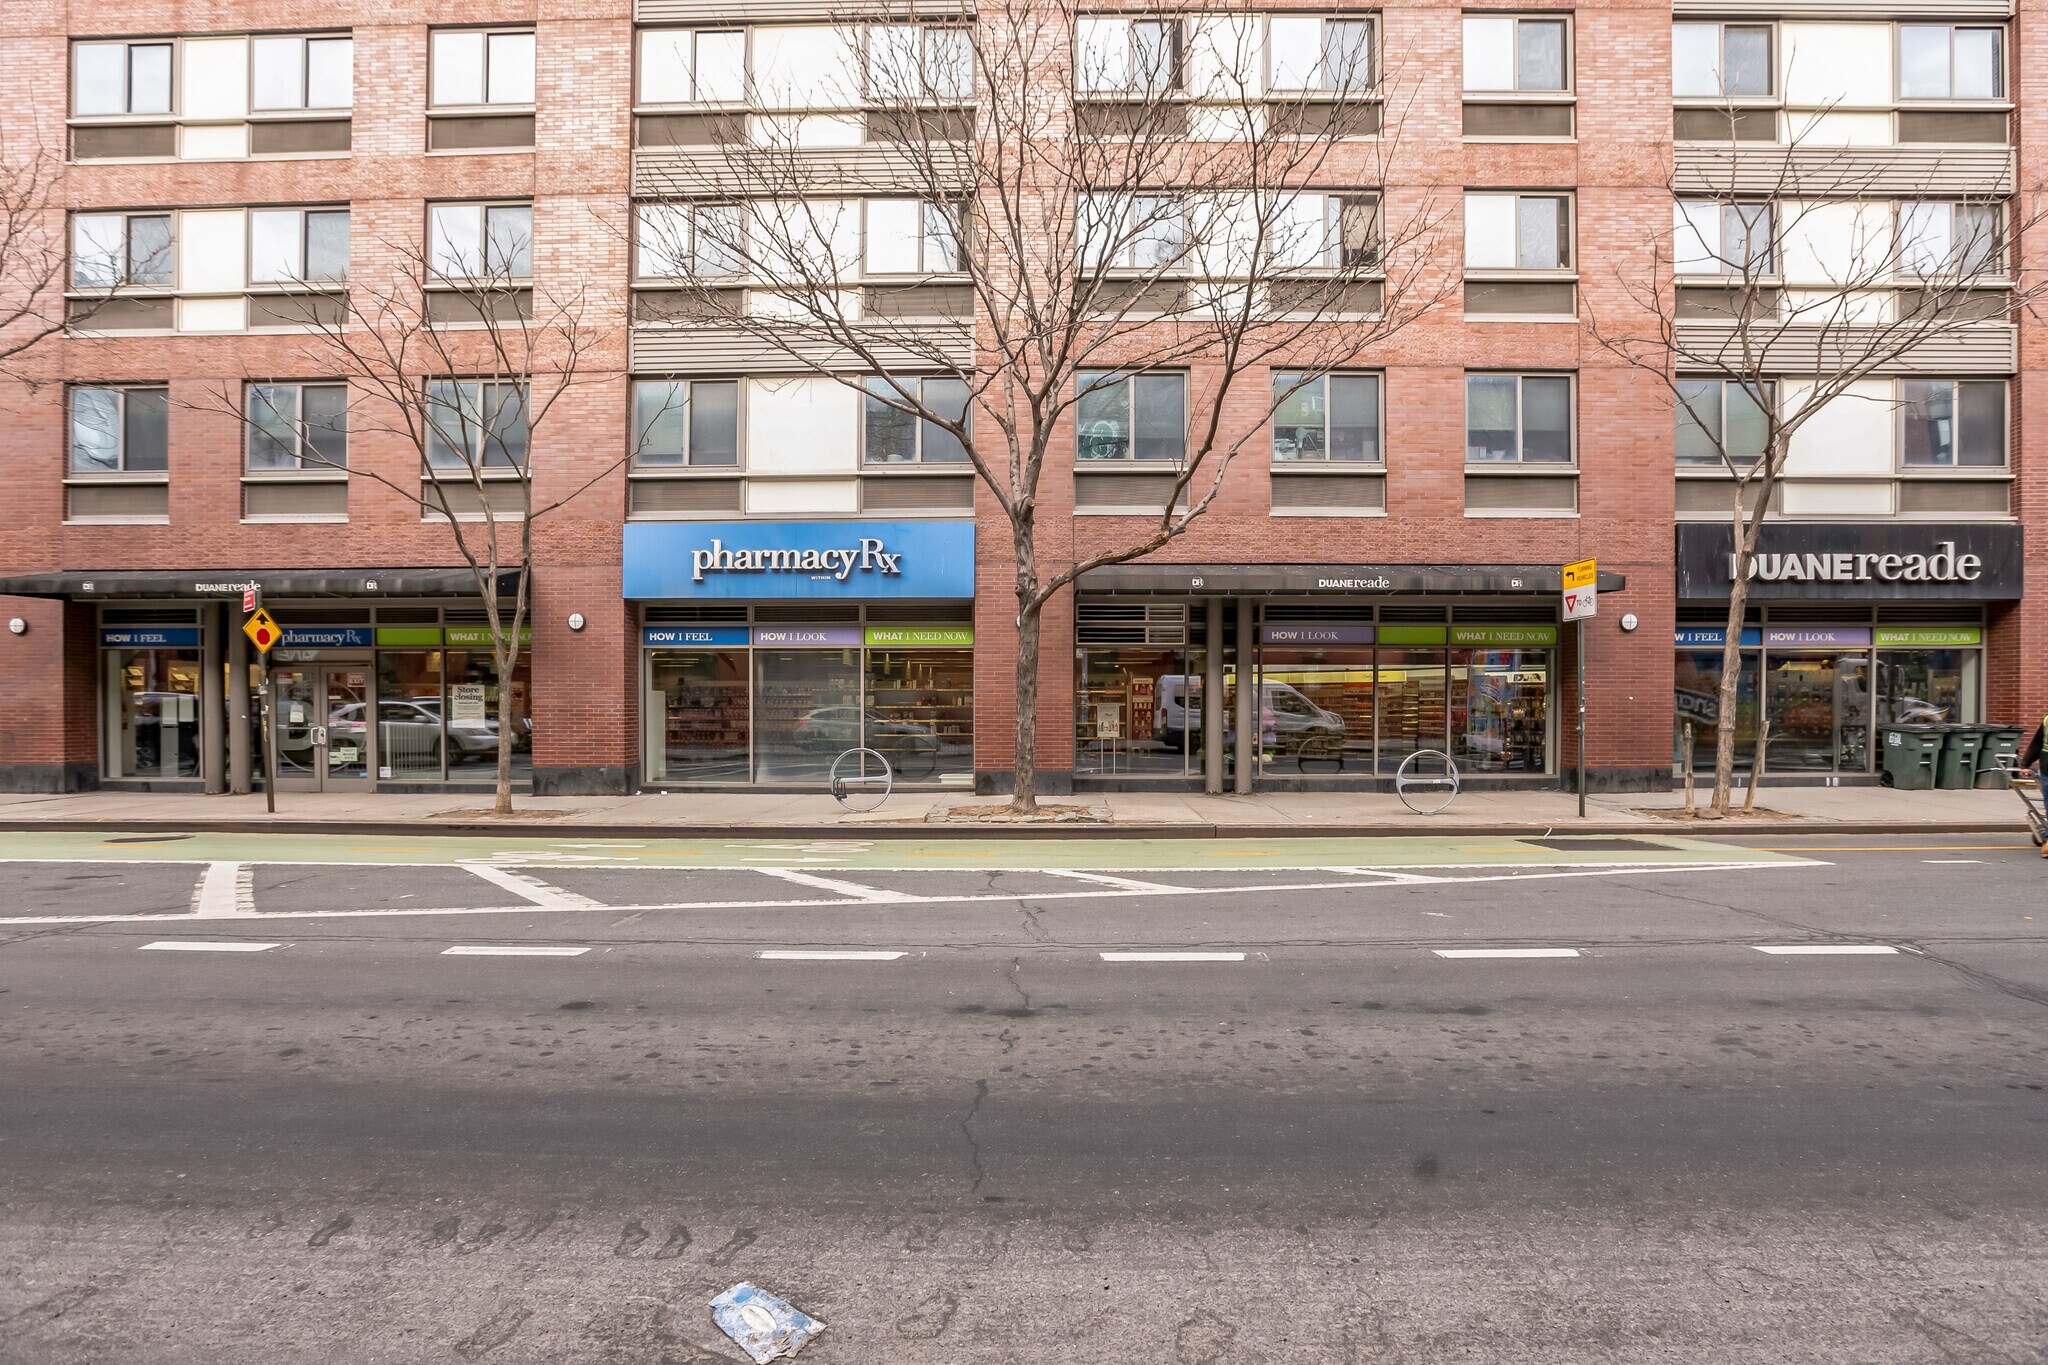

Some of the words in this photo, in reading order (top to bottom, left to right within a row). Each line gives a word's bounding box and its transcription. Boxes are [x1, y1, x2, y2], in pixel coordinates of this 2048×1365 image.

[105, 634, 131, 642] HOW
[134, 634, 138, 642] I
[140, 634, 167, 642] FEEL
[450, 632, 479, 641] WHAT
[649, 632, 675, 641] HOW
[678, 632, 682, 641] I
[685, 632, 713, 642] FEEL
[760, 632, 786, 641] HOW
[789, 632, 793, 641] I
[796, 632, 827, 641] LOOK
[873, 632, 903, 640] WHAT
[906, 632, 910, 640] I
[912, 632, 942, 640] NEED
[943, 632, 969, 641] NOW
[1271, 631, 1298, 640] HOW
[1301, 631, 1305, 640] I
[1308, 631, 1339, 640] LOOK
[1456, 632, 1487, 640] WHAT
[1489, 632, 1493, 640] I
[1495, 632, 1525, 641] NEED
[1527, 632, 1551, 641] NOW
[1688, 633, 1692, 641] I
[1694, 633, 1723, 642] FEEL
[1770, 632, 1796, 641] HOW
[1798, 632, 1803, 641] I
[1805, 632, 1836, 641] LOOK
[1880, 633, 1910, 642] WHAT
[1911, 633, 1917, 642] I
[1918, 633, 1947, 642] NEED
[1948, 633, 1973, 642] NOW
[454, 692, 484, 702] closing
